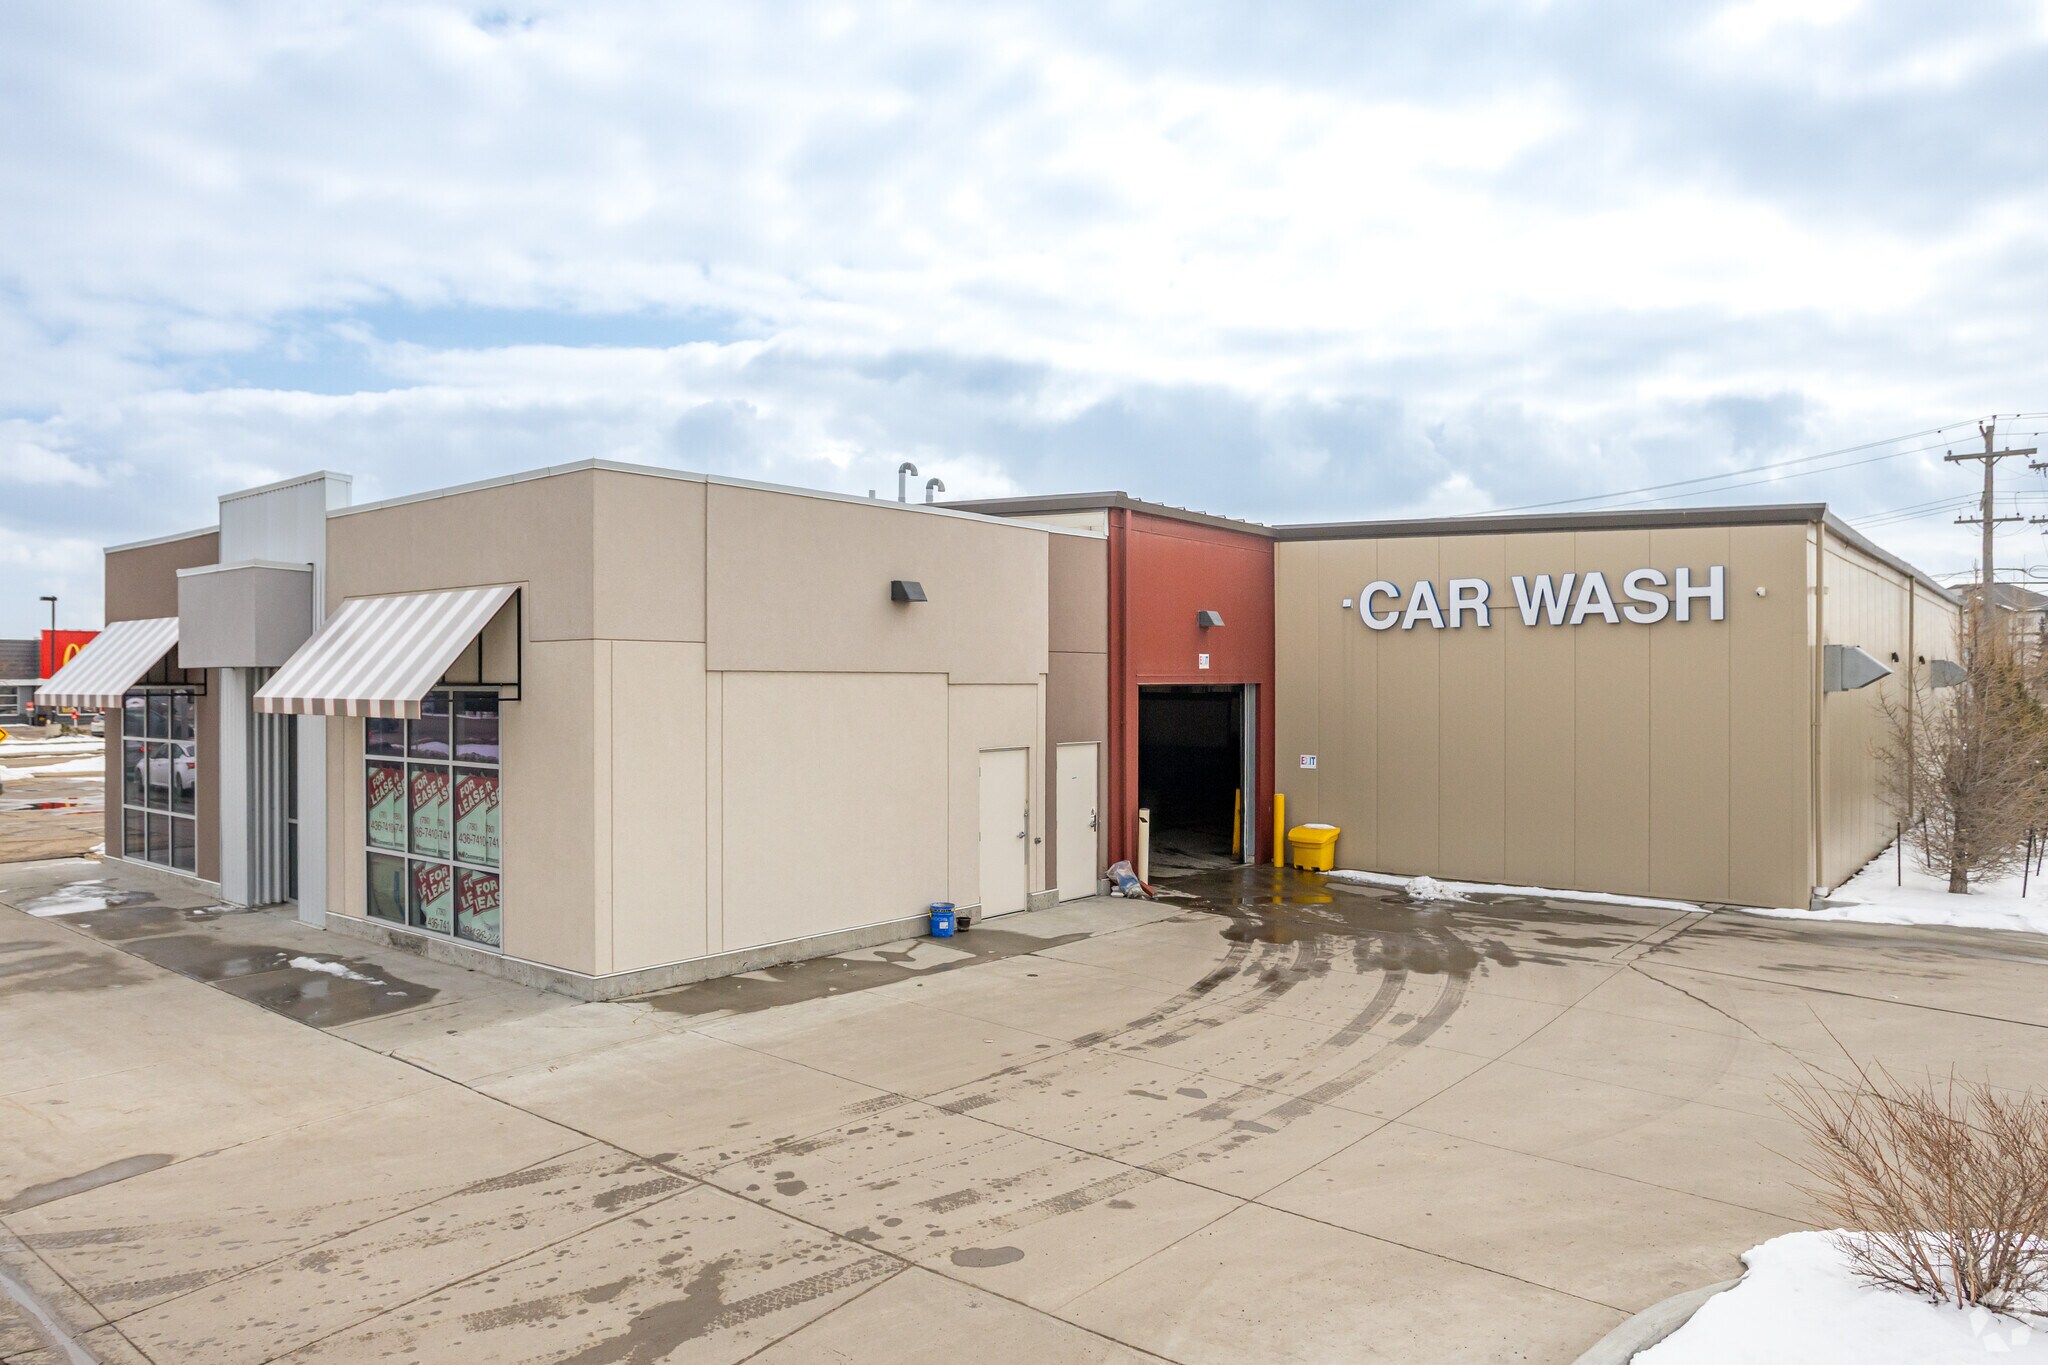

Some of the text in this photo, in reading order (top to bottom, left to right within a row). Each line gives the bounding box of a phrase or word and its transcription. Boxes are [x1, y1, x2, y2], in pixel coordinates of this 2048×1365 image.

[1359, 565, 1726, 631] CAR WASH
[372, 771, 385, 789] FOR
[414, 775, 428, 794] FOR
[459, 779, 475, 799] FOR
[370, 777, 394, 806] LEASE
[412, 781, 438, 810] LEASE
[457, 785, 486, 816] LEASE
[429, 866, 449, 884] FOR
[426, 877, 450, 901] LEAS
[476, 880, 498, 895] FOR
[474, 892, 500, 912] LEAS
